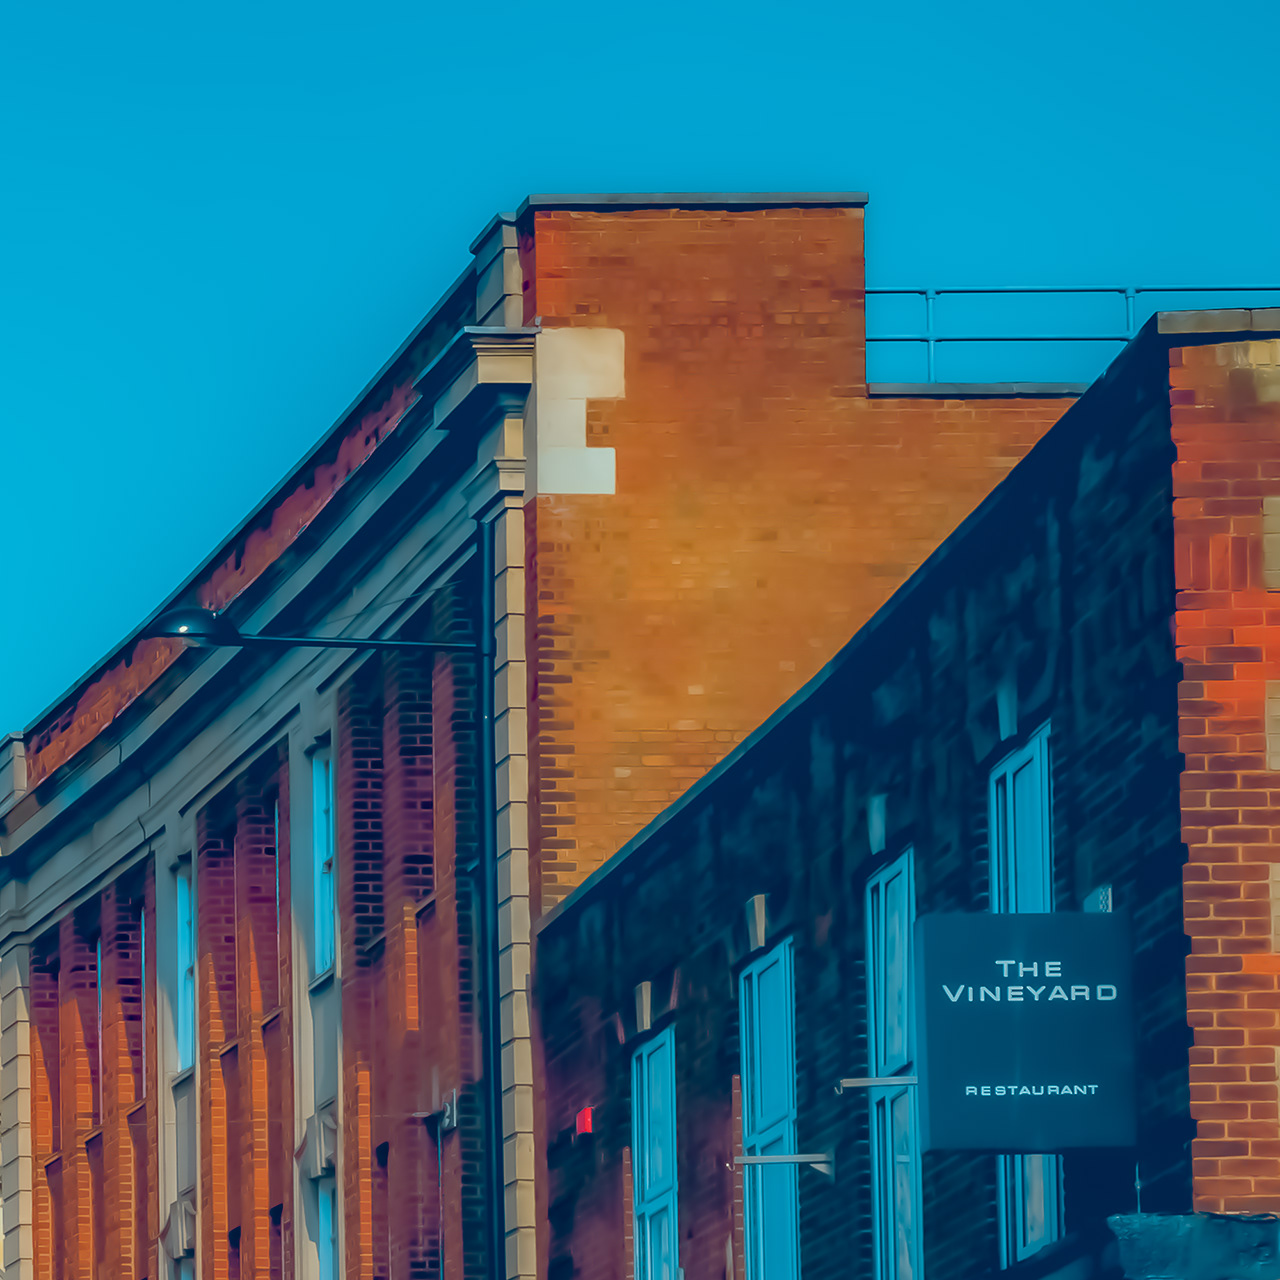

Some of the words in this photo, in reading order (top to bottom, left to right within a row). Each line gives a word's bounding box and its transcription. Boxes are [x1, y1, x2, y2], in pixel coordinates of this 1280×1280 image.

[995, 959, 1062, 978] THE
[942, 984, 1117, 1002] VINEYARD
[965, 1084, 1099, 1097] RESTAURANT
